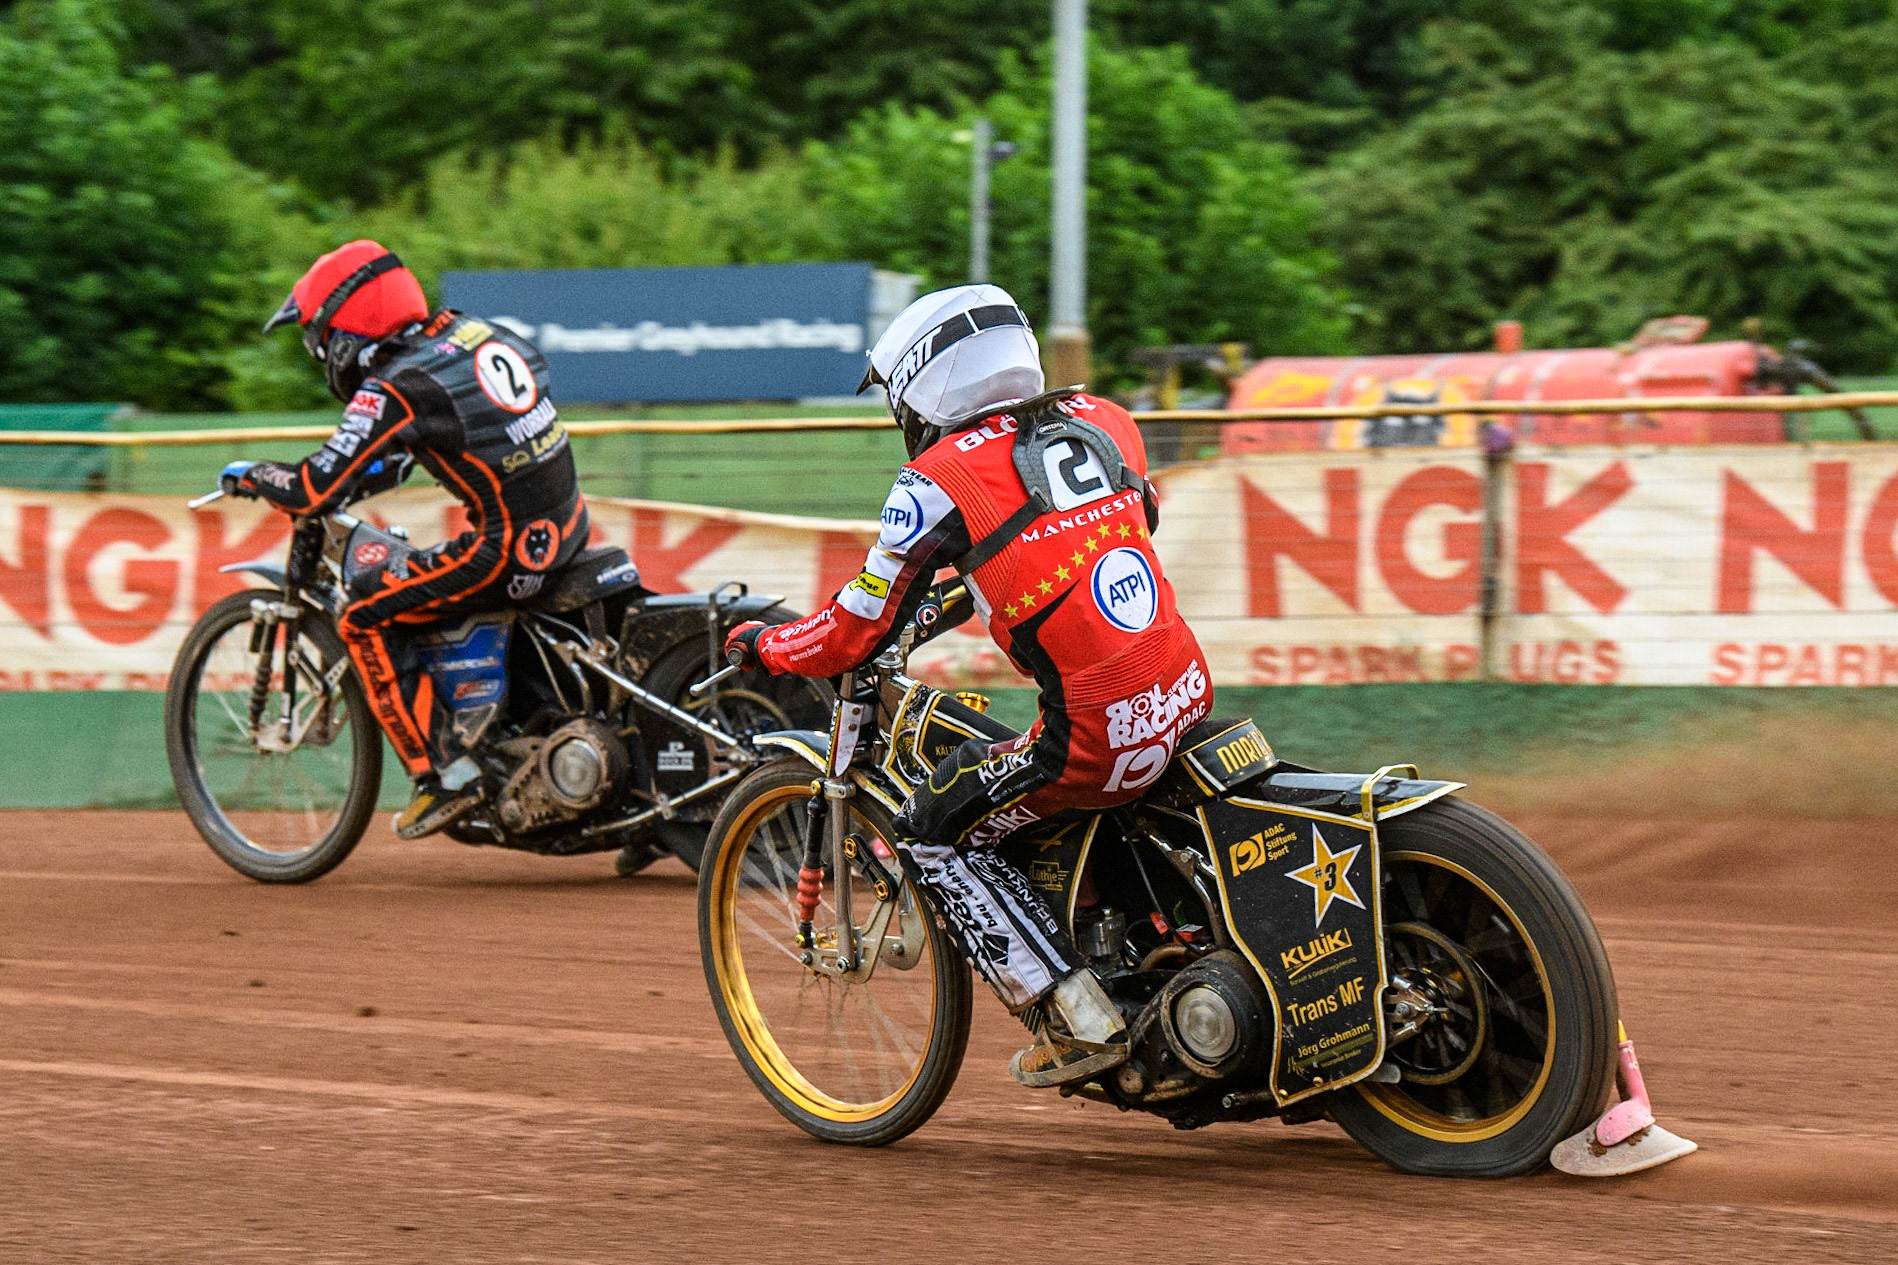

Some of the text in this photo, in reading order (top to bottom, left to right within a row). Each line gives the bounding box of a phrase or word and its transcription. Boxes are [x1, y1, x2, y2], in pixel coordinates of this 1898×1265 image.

[491, 354, 527, 400] 2
[1046, 438, 1105, 496] 2
[881, 506, 913, 528] ATPI
[1021, 491, 1142, 544] MANCHESTE
[1238, 461, 1637, 619] NGK
[1108, 571, 1147, 608] ATPI
[1443, 640, 1624, 684] PUGS
[1106, 669, 1206, 749] RACING
[1177, 701, 1206, 736] ADAC
[1264, 822, 1285, 839] ADAC
[1266, 832, 1298, 851] Stiftung
[1268, 845, 1290, 861] Sport
[1287, 976, 1366, 1027] Trans MF
[1298, 1043, 1320, 1058] Jörg
[1318, 1022, 1371, 1049] Grohmann
